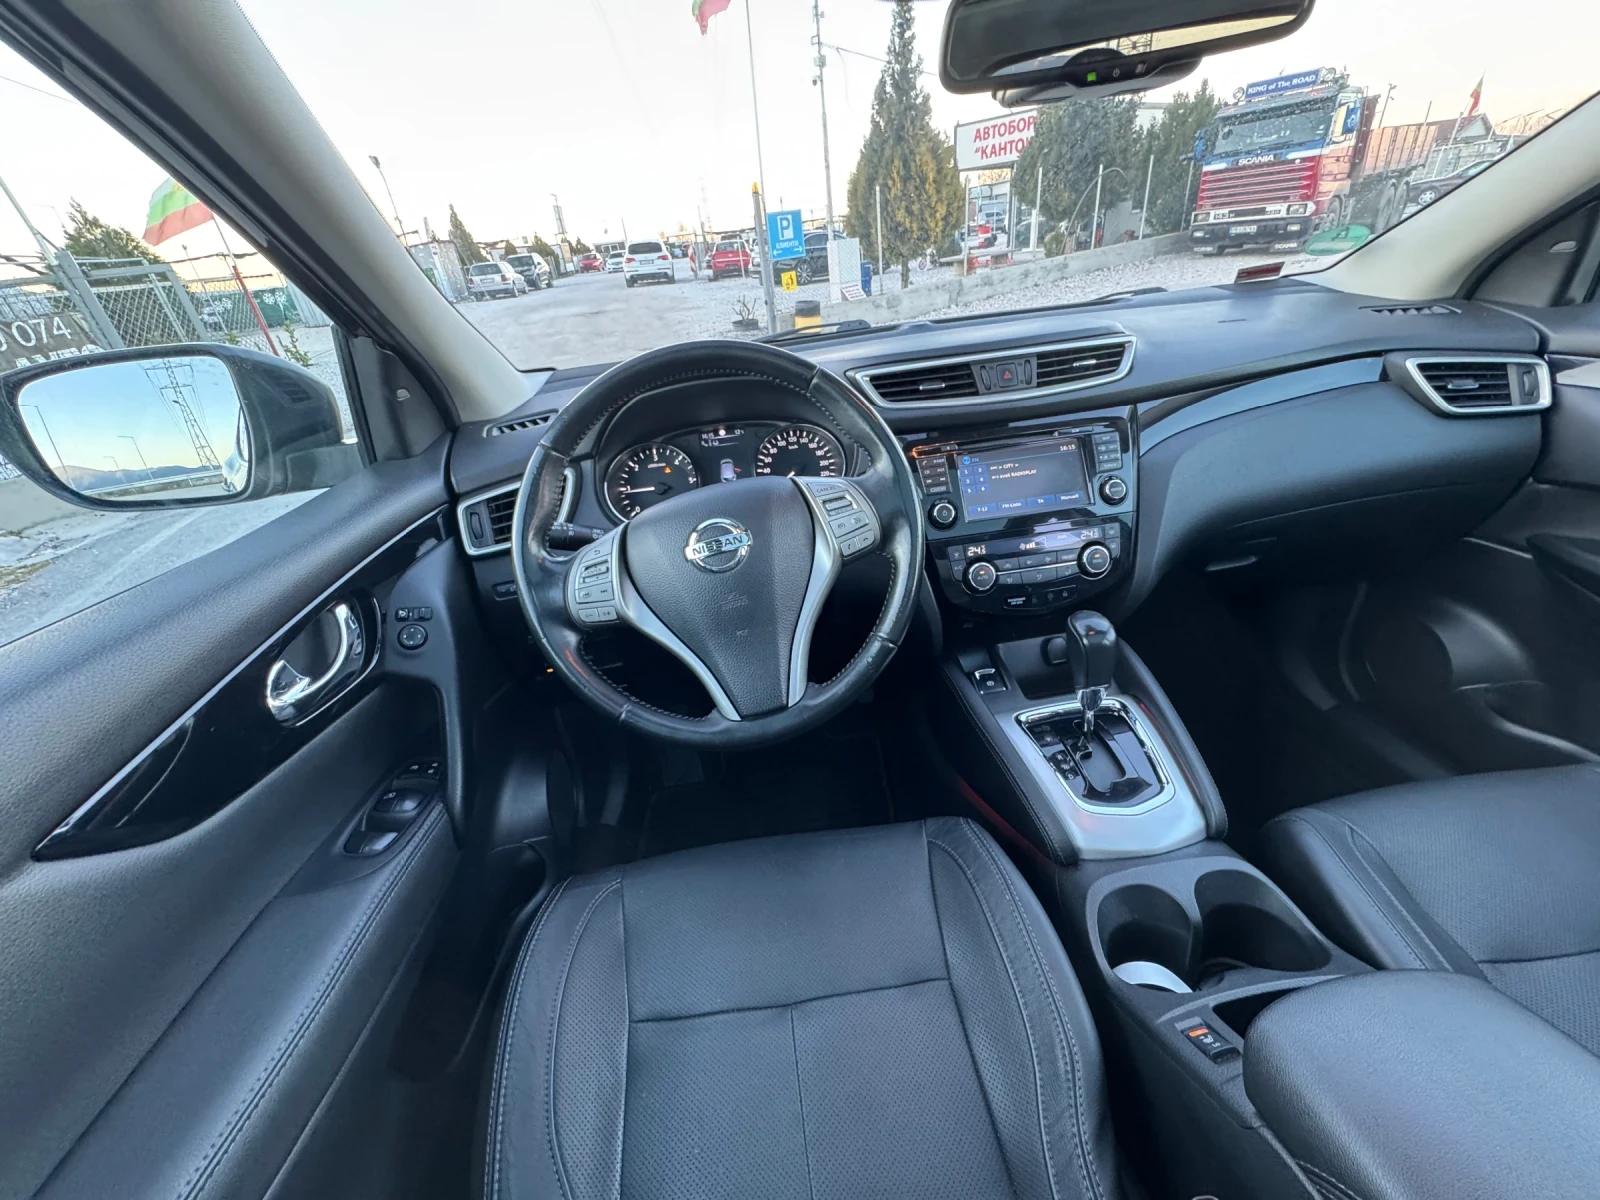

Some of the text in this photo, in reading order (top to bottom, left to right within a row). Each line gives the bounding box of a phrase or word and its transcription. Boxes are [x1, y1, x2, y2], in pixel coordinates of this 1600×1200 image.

[1247, 84, 1267, 95] KING
[1277, 80, 1291, 88] The
[1291, 74, 1316, 86] ROAD
[1238, 154, 1274, 166] SCANIA
[779, 216, 791, 239] P
[11, 316, 72, 347] 074
[816, 485, 836, 493] CANCEL
[692, 535, 744, 557] NISSAN
